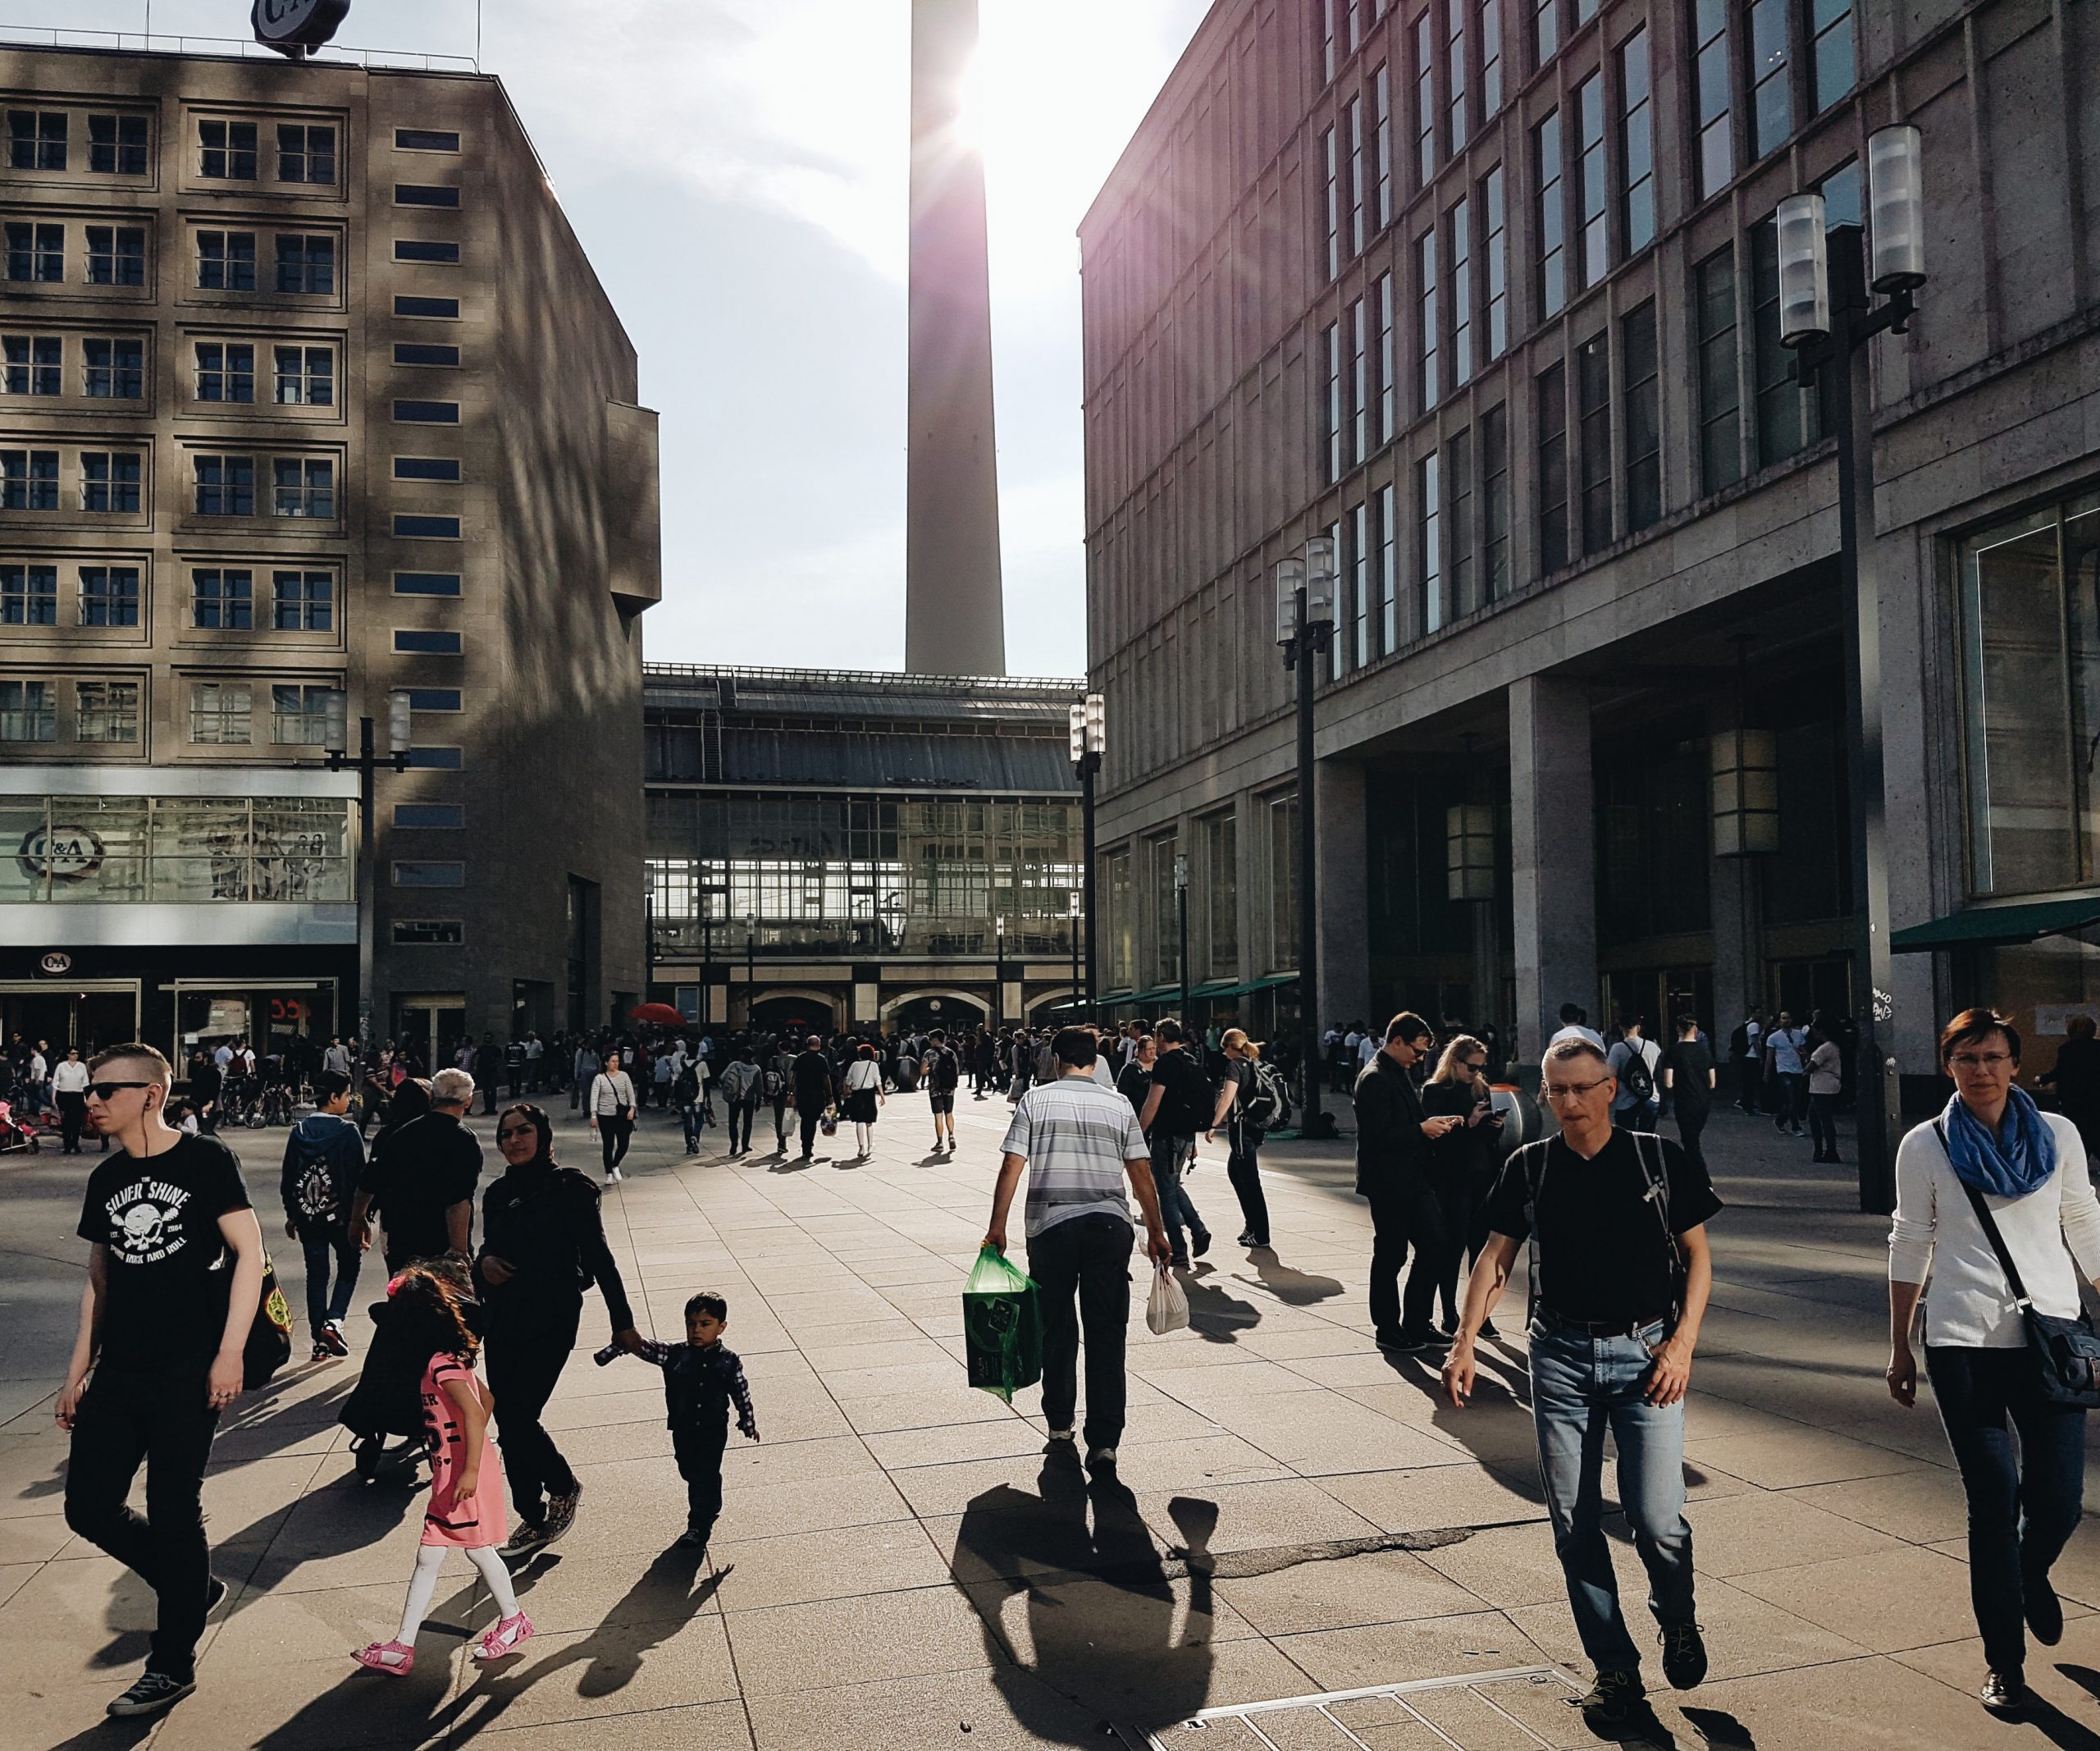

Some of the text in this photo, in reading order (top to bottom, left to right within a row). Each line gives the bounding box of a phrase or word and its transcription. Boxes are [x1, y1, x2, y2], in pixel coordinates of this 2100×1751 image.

[35, 839, 88, 863] C&A
[44, 955, 67, 968] C&A
[105, 1182, 191, 1216] SILVER SHINE
[146, 1249, 166, 1263] AND
[166, 1237, 188, 1255] ROLL
